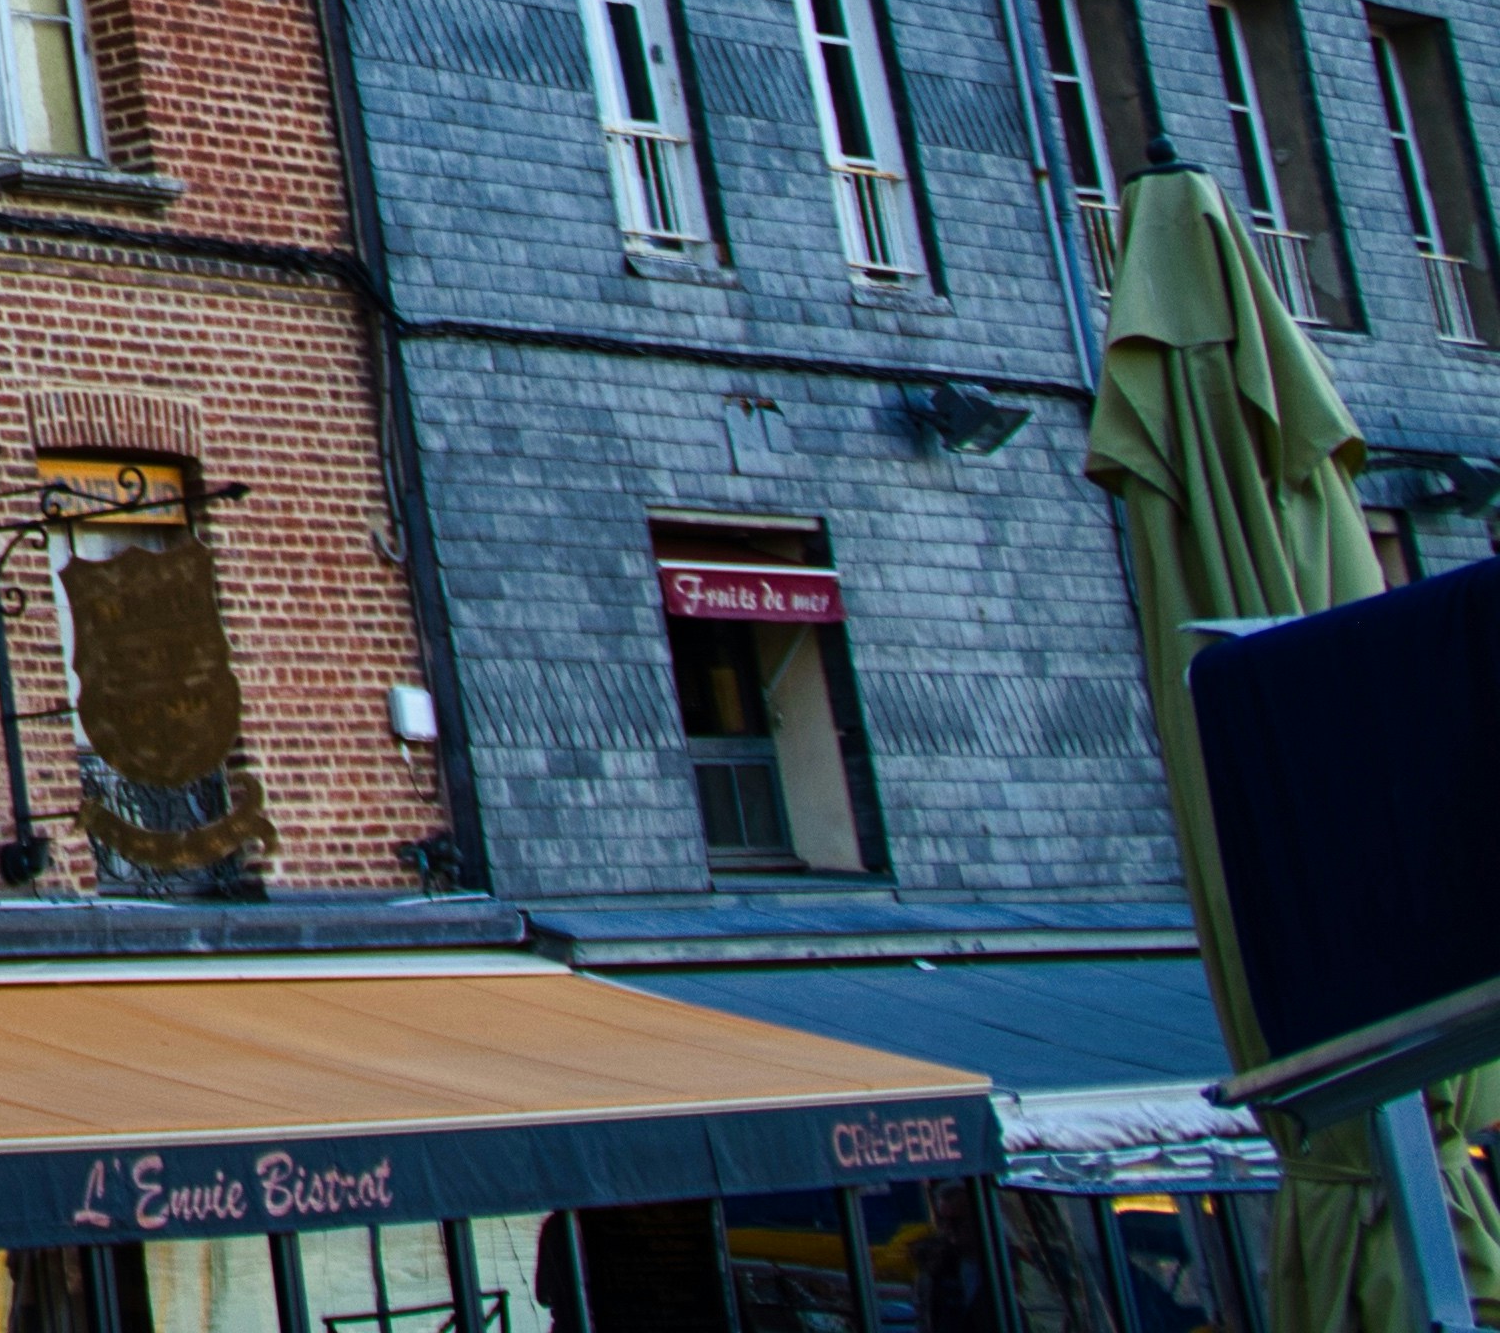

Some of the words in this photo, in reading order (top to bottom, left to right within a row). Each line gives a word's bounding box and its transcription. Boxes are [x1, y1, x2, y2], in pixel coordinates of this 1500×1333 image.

[673, 573, 758, 616] Fruits
[762, 579, 786, 611] de
[791, 593, 830, 613] mer
[256, 1149, 395, 1217] Bistrot
